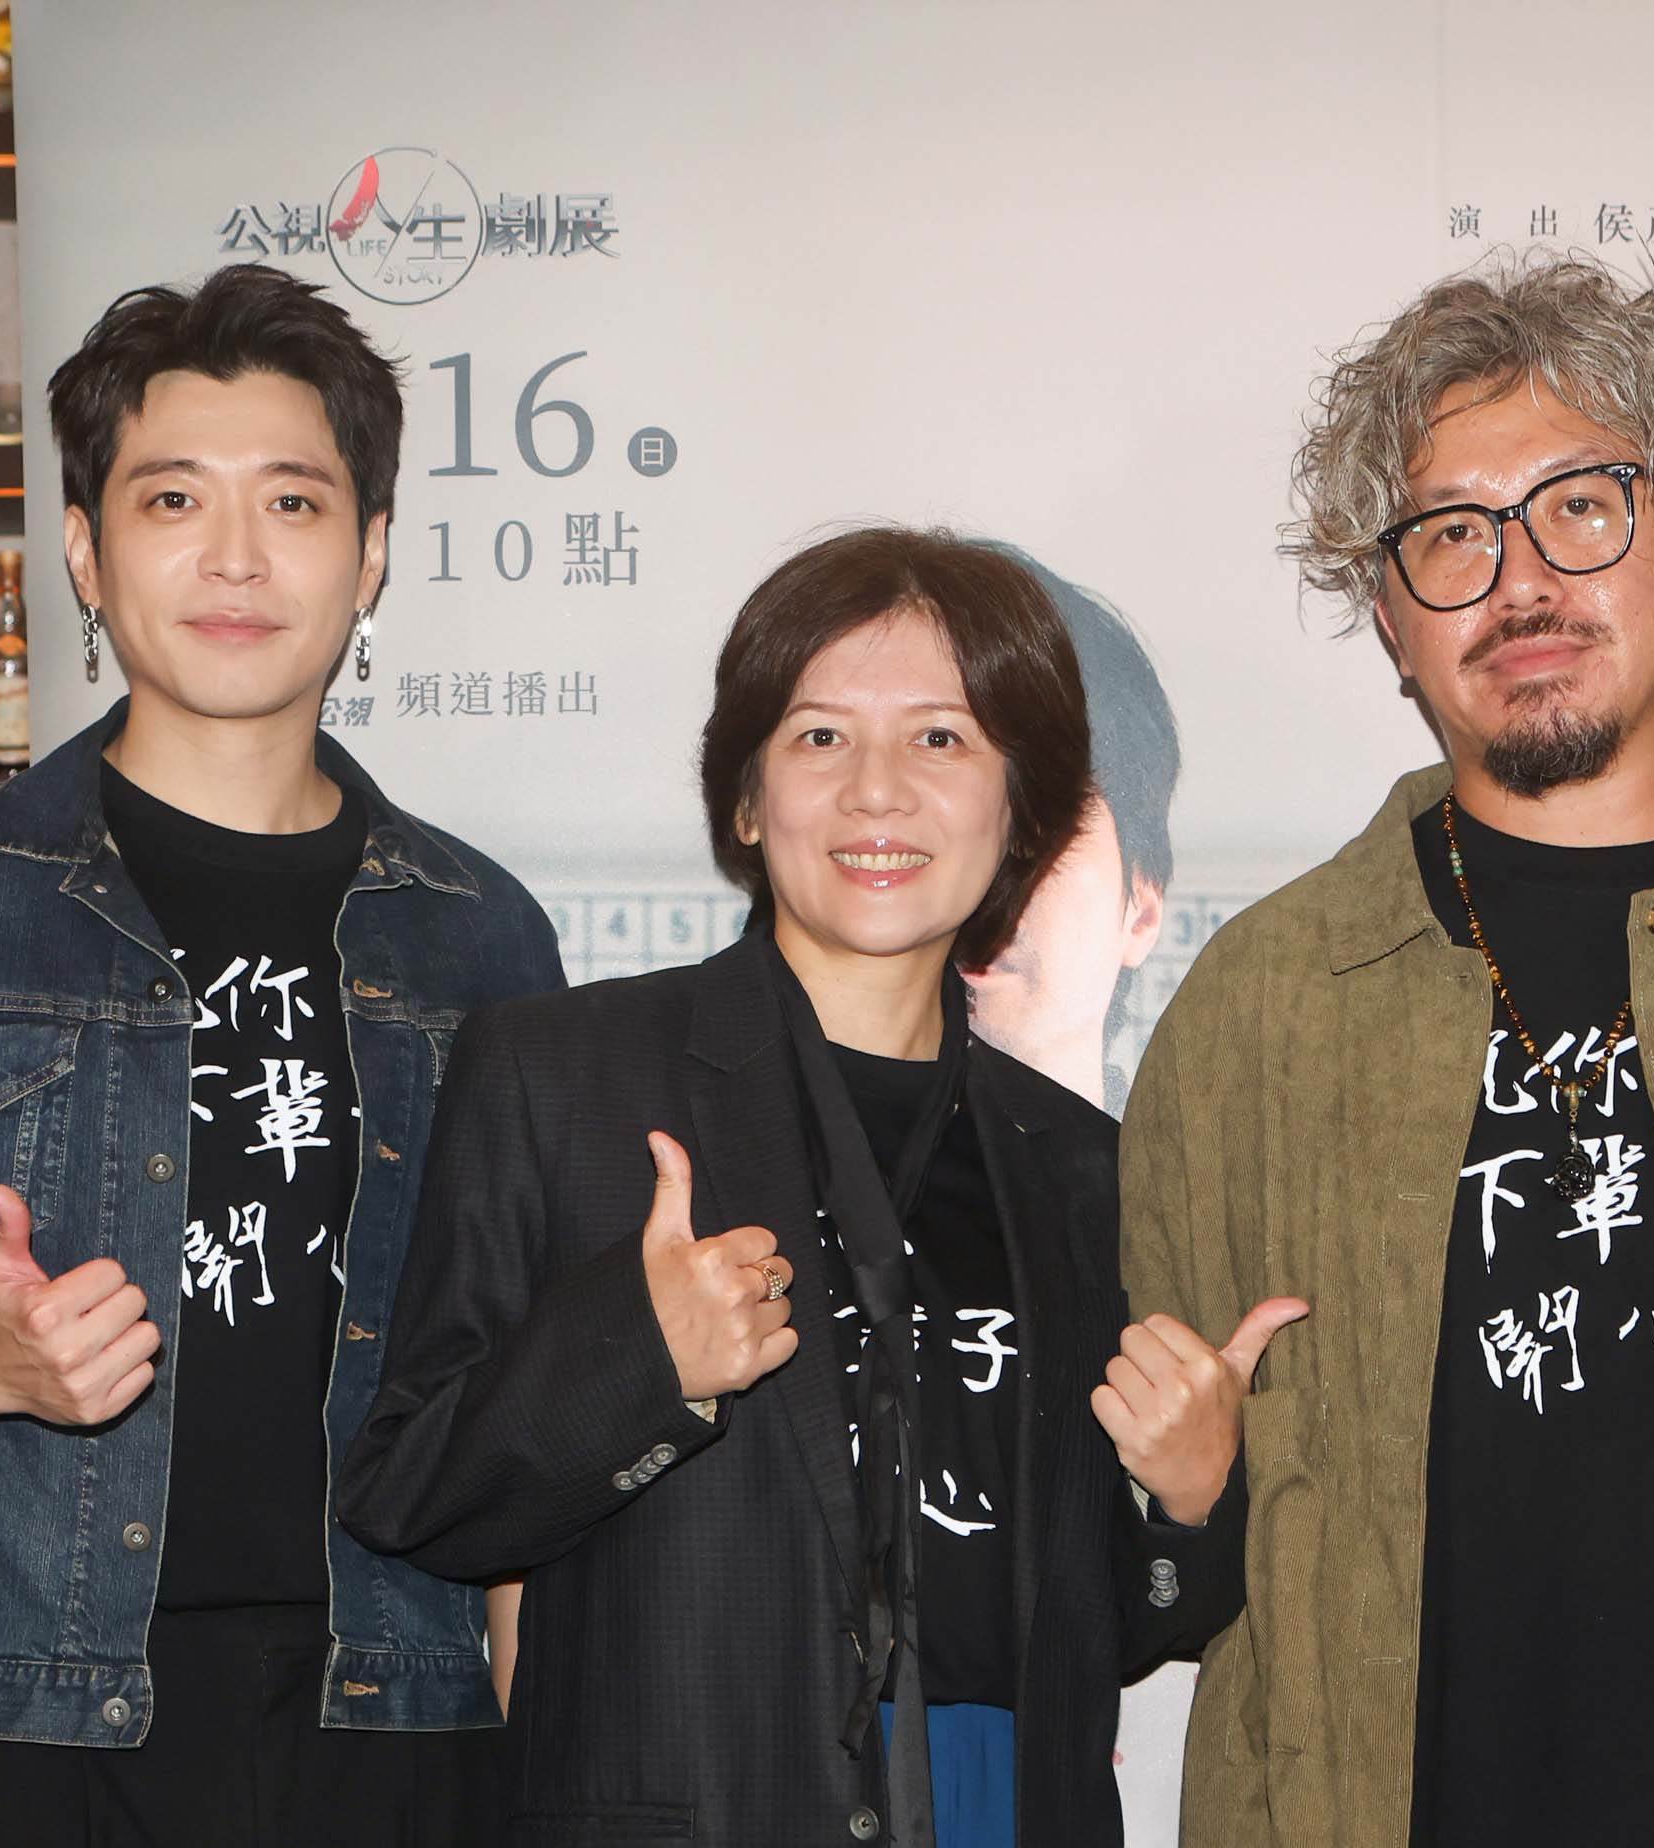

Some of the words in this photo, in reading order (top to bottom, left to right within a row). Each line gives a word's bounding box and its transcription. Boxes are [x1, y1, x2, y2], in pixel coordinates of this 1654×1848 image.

[215, 155, 620, 264] 公視人生劇展
[1448, 203, 1558, 240] 演出
[348, 239, 388, 257] LIFE
[428, 350, 595, 478] 16
[641, 437, 664, 467] 日
[383, 510, 641, 588] 10點
[396, 671, 599, 718] 頻道播出
